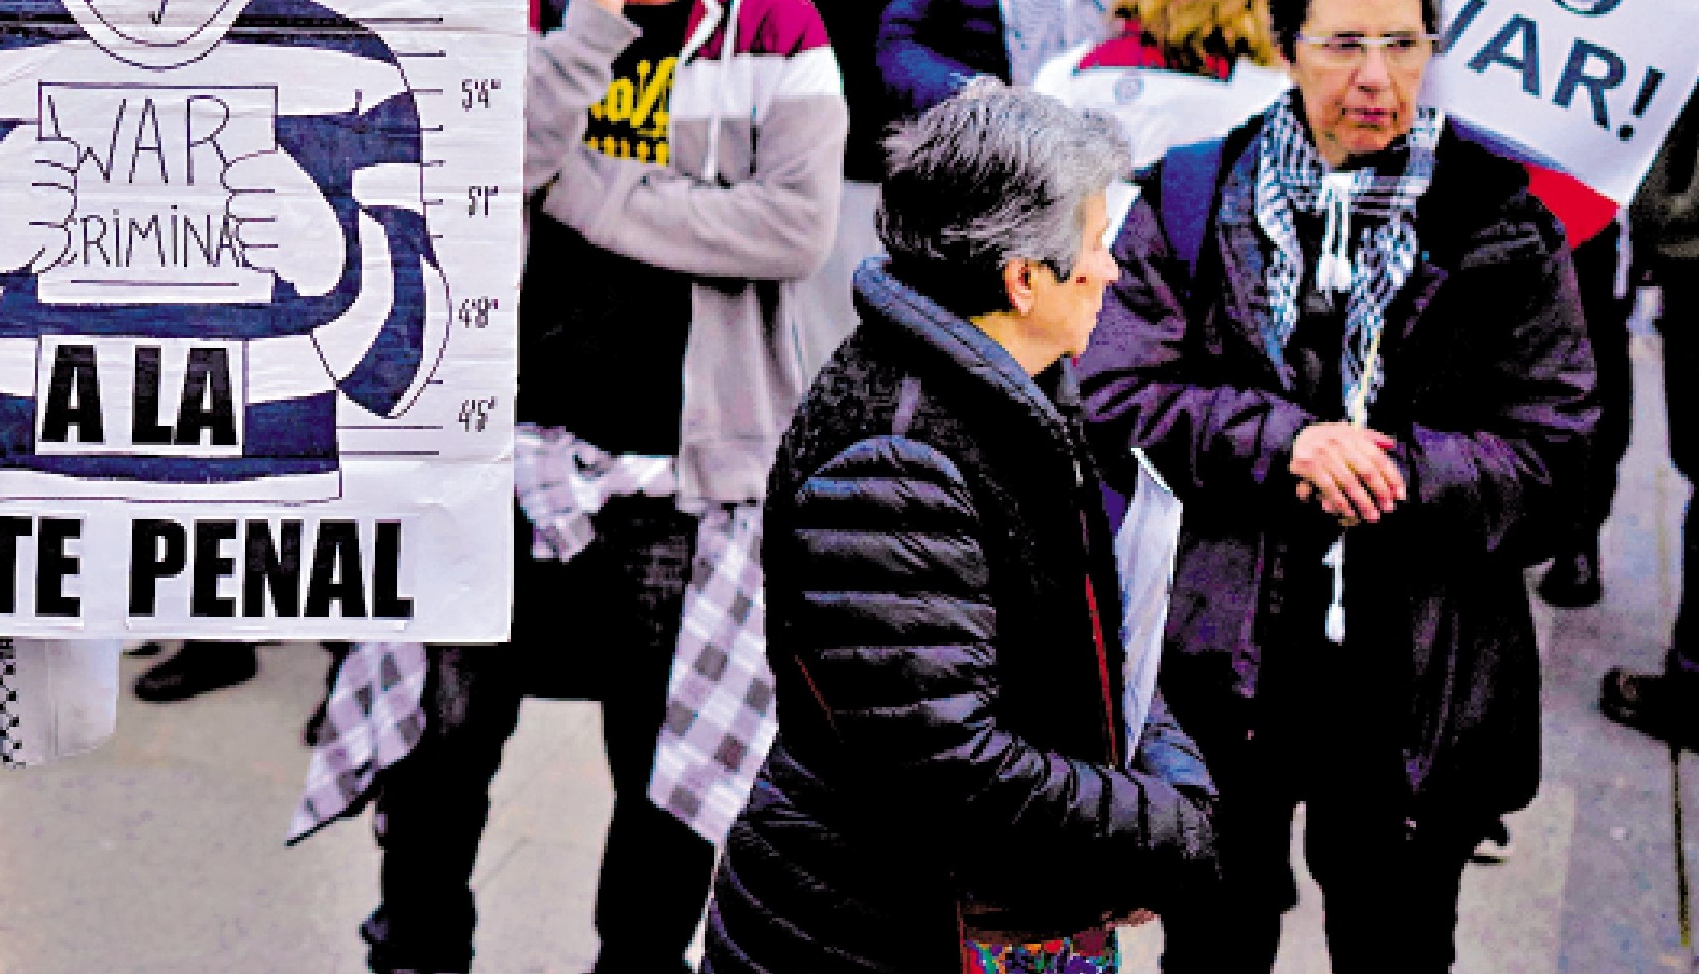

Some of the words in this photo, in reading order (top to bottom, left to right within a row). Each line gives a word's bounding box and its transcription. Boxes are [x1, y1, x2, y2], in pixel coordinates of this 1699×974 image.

[47, 94, 231, 187] WAR
[43, 344, 105, 444] A
[131, 345, 238, 447] LA
[128, 515, 415, 620] PENAL
